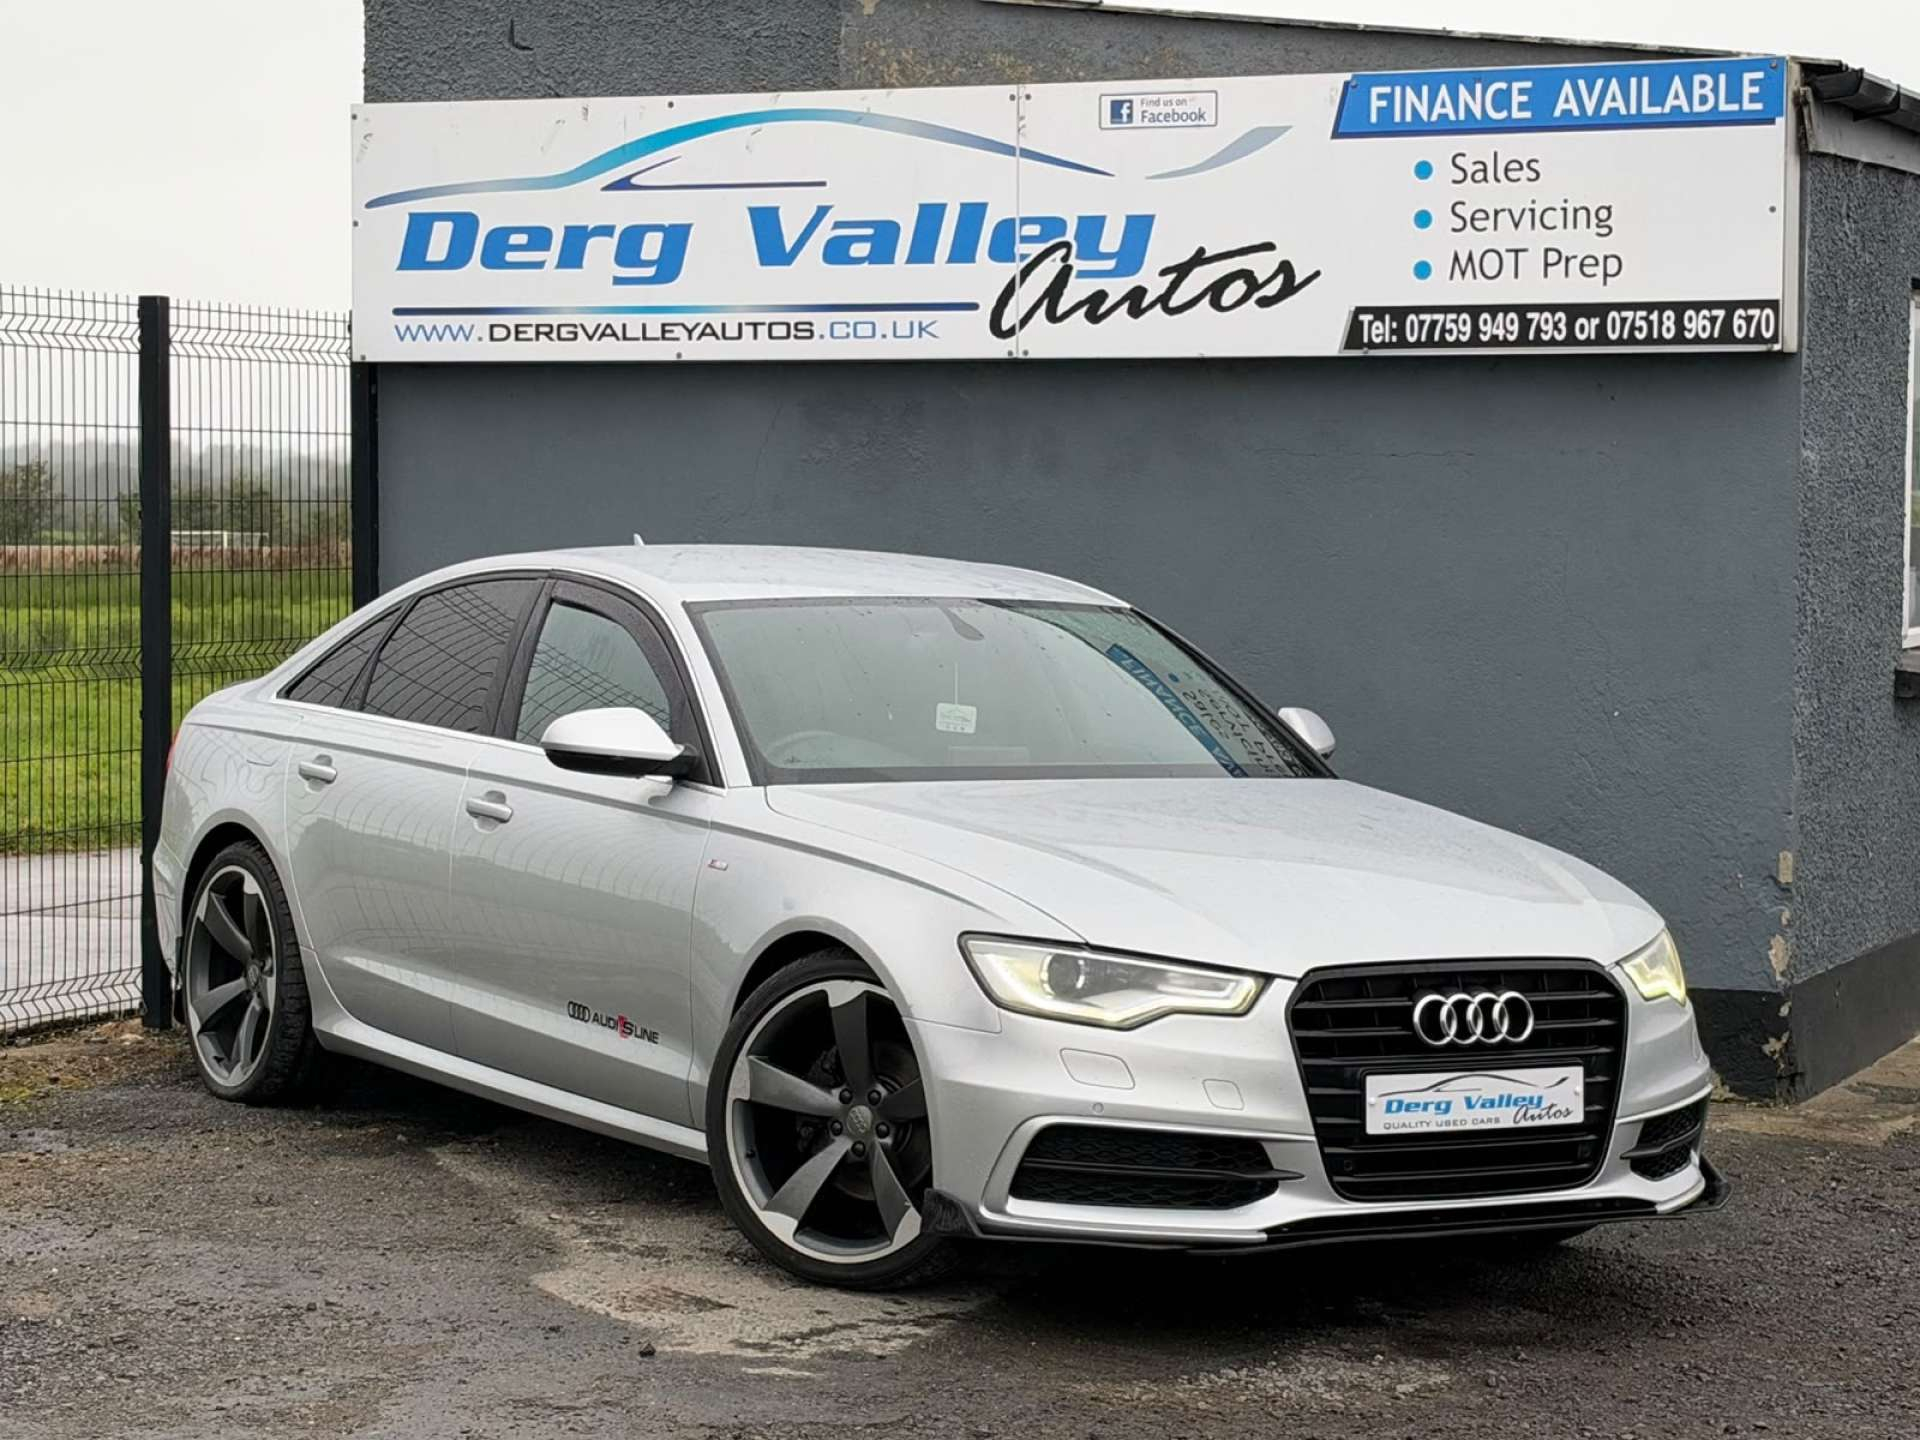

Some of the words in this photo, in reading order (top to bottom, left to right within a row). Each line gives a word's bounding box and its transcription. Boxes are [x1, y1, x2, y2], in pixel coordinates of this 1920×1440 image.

[1140, 97, 1160, 107] Find
[1163, 98, 1174, 107] us
[1175, 97, 1188, 106] on
[1369, 81, 1533, 124] FINANCE
[1553, 71, 1765, 118] AVAILABLE
[1140, 107, 1207, 123] Facebook
[1450, 151, 1541, 185] Sales
[1450, 199, 1614, 237] Servicing
[395, 211, 693, 287] Derg
[747, 201, 1156, 279] Valley
[1449, 248, 1529, 281] MOT
[1543, 247, 1623, 286] Prep
[989, 240, 1321, 340] Autos
[394, 320, 940, 343] WWW.DERGVALLEYAUTOS.CO.UK
[1358, 314, 1398, 344] Tel:
[1405, 313, 1472, 343] 07759
[1478, 312, 1520, 342] 949
[1526, 311, 1567, 342] 793
[1574, 316, 1600, 341] or
[1606, 309, 1676, 341] 07518
[1683, 309, 1726, 340] 967
[1732, 307, 1776, 340] 670
[591, 1012, 618, 1032] AUDI
[634, 1025, 660, 1044] LINE
[1384, 1099, 1453, 1116] Derg
[1464, 1093, 1544, 1110] Valley
[1513, 1103, 1573, 1125] Autos
[1383, 1120, 1432, 1131] QUALITY
[1436, 1118, 1468, 1128] USED
[1471, 1116, 1501, 1126] CARS
